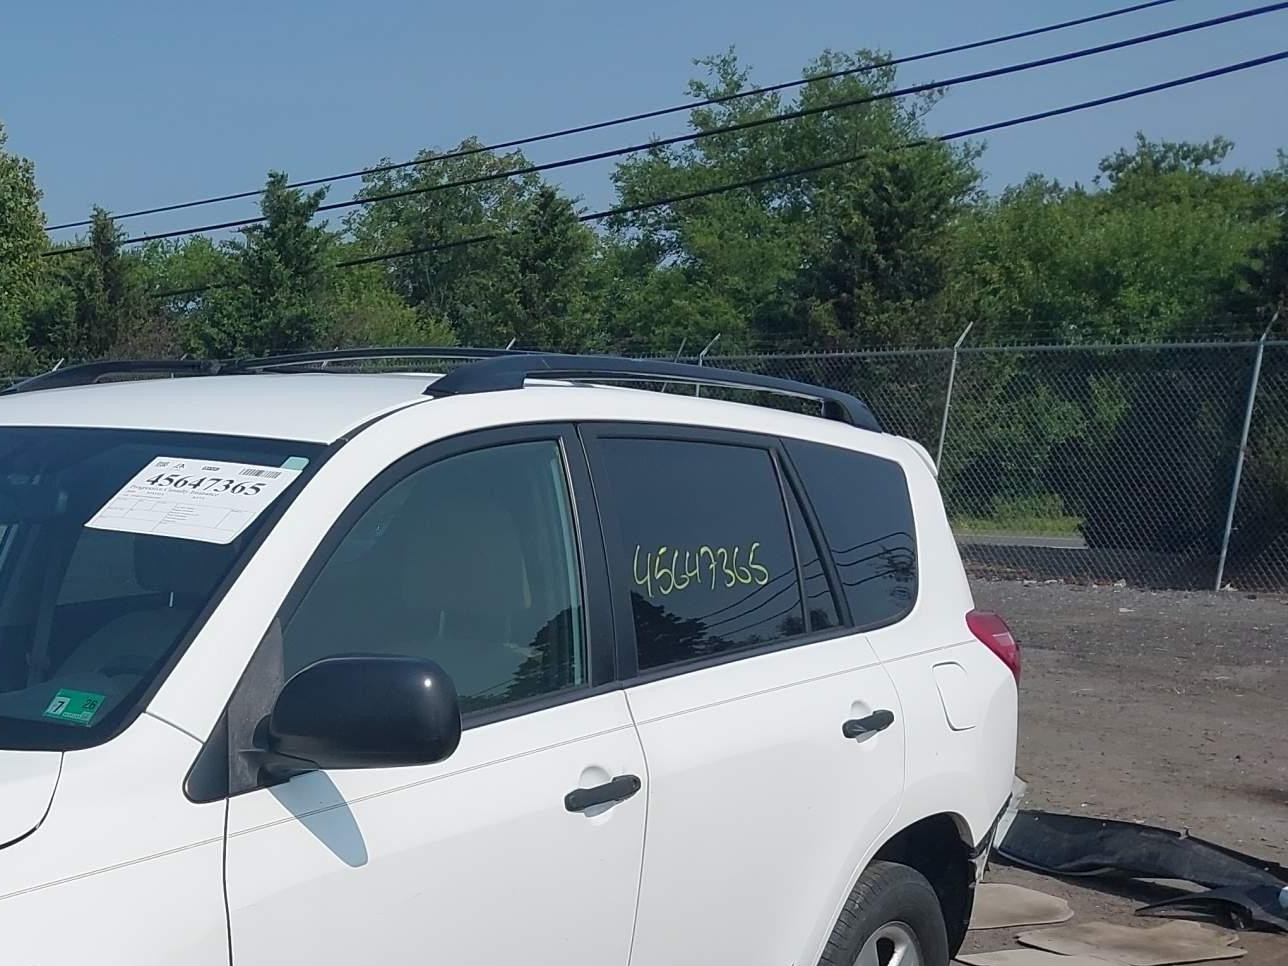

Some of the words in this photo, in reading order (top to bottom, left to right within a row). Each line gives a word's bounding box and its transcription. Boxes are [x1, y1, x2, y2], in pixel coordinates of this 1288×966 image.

[146, 472, 268, 496] 45647365
[633, 542, 769, 598] 45647365
[53, 701, 65, 713] 7
